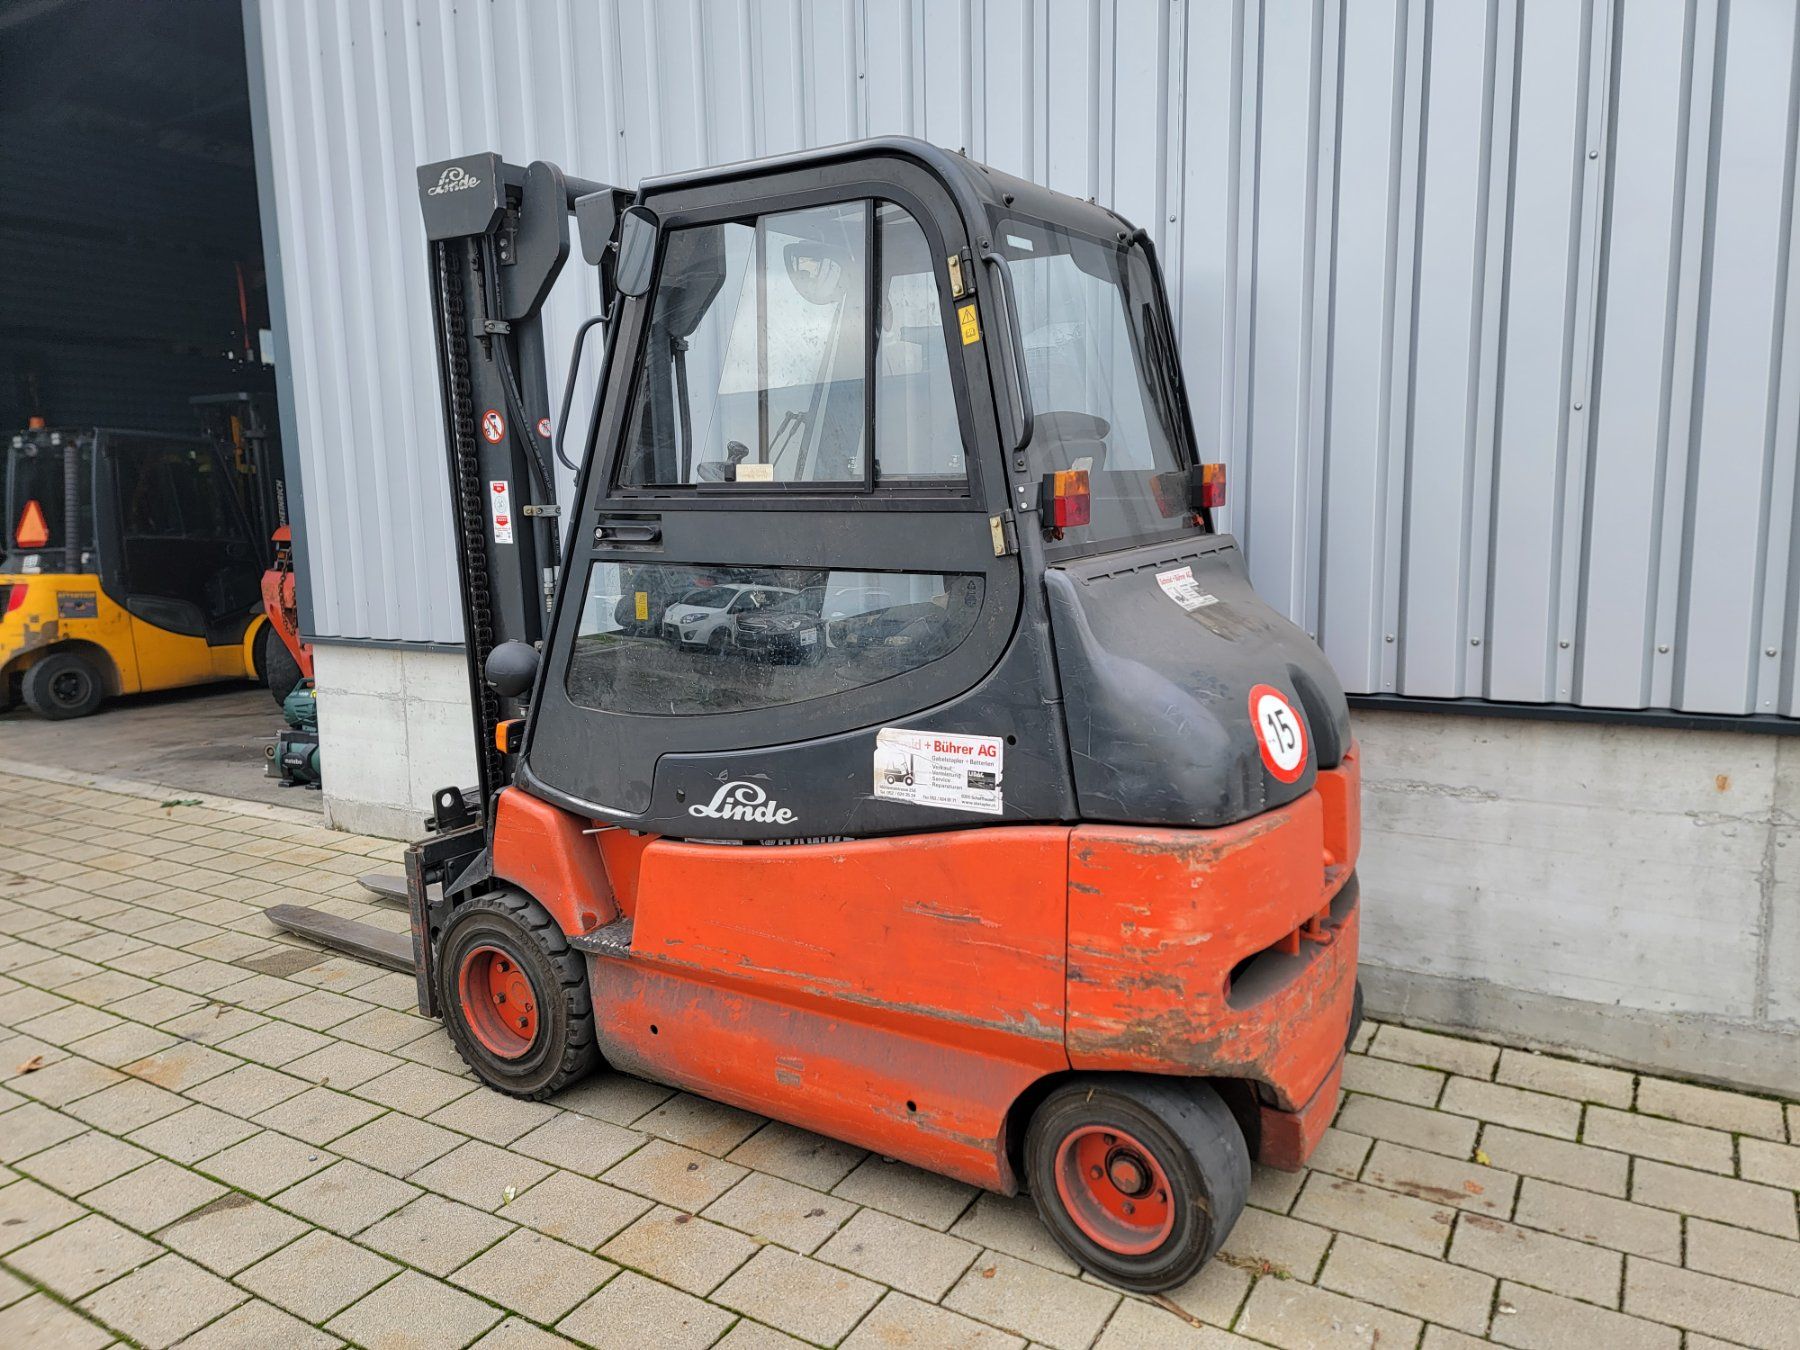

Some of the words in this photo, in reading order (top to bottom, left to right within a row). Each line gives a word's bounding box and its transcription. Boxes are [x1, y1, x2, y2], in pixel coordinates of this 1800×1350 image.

[427, 166, 482, 196] Linde
[933, 739, 974, 756] Bührer
[977, 743, 997, 758] AG
[1267, 708, 1296, 754] 15
[688, 781, 799, 825] Linde
